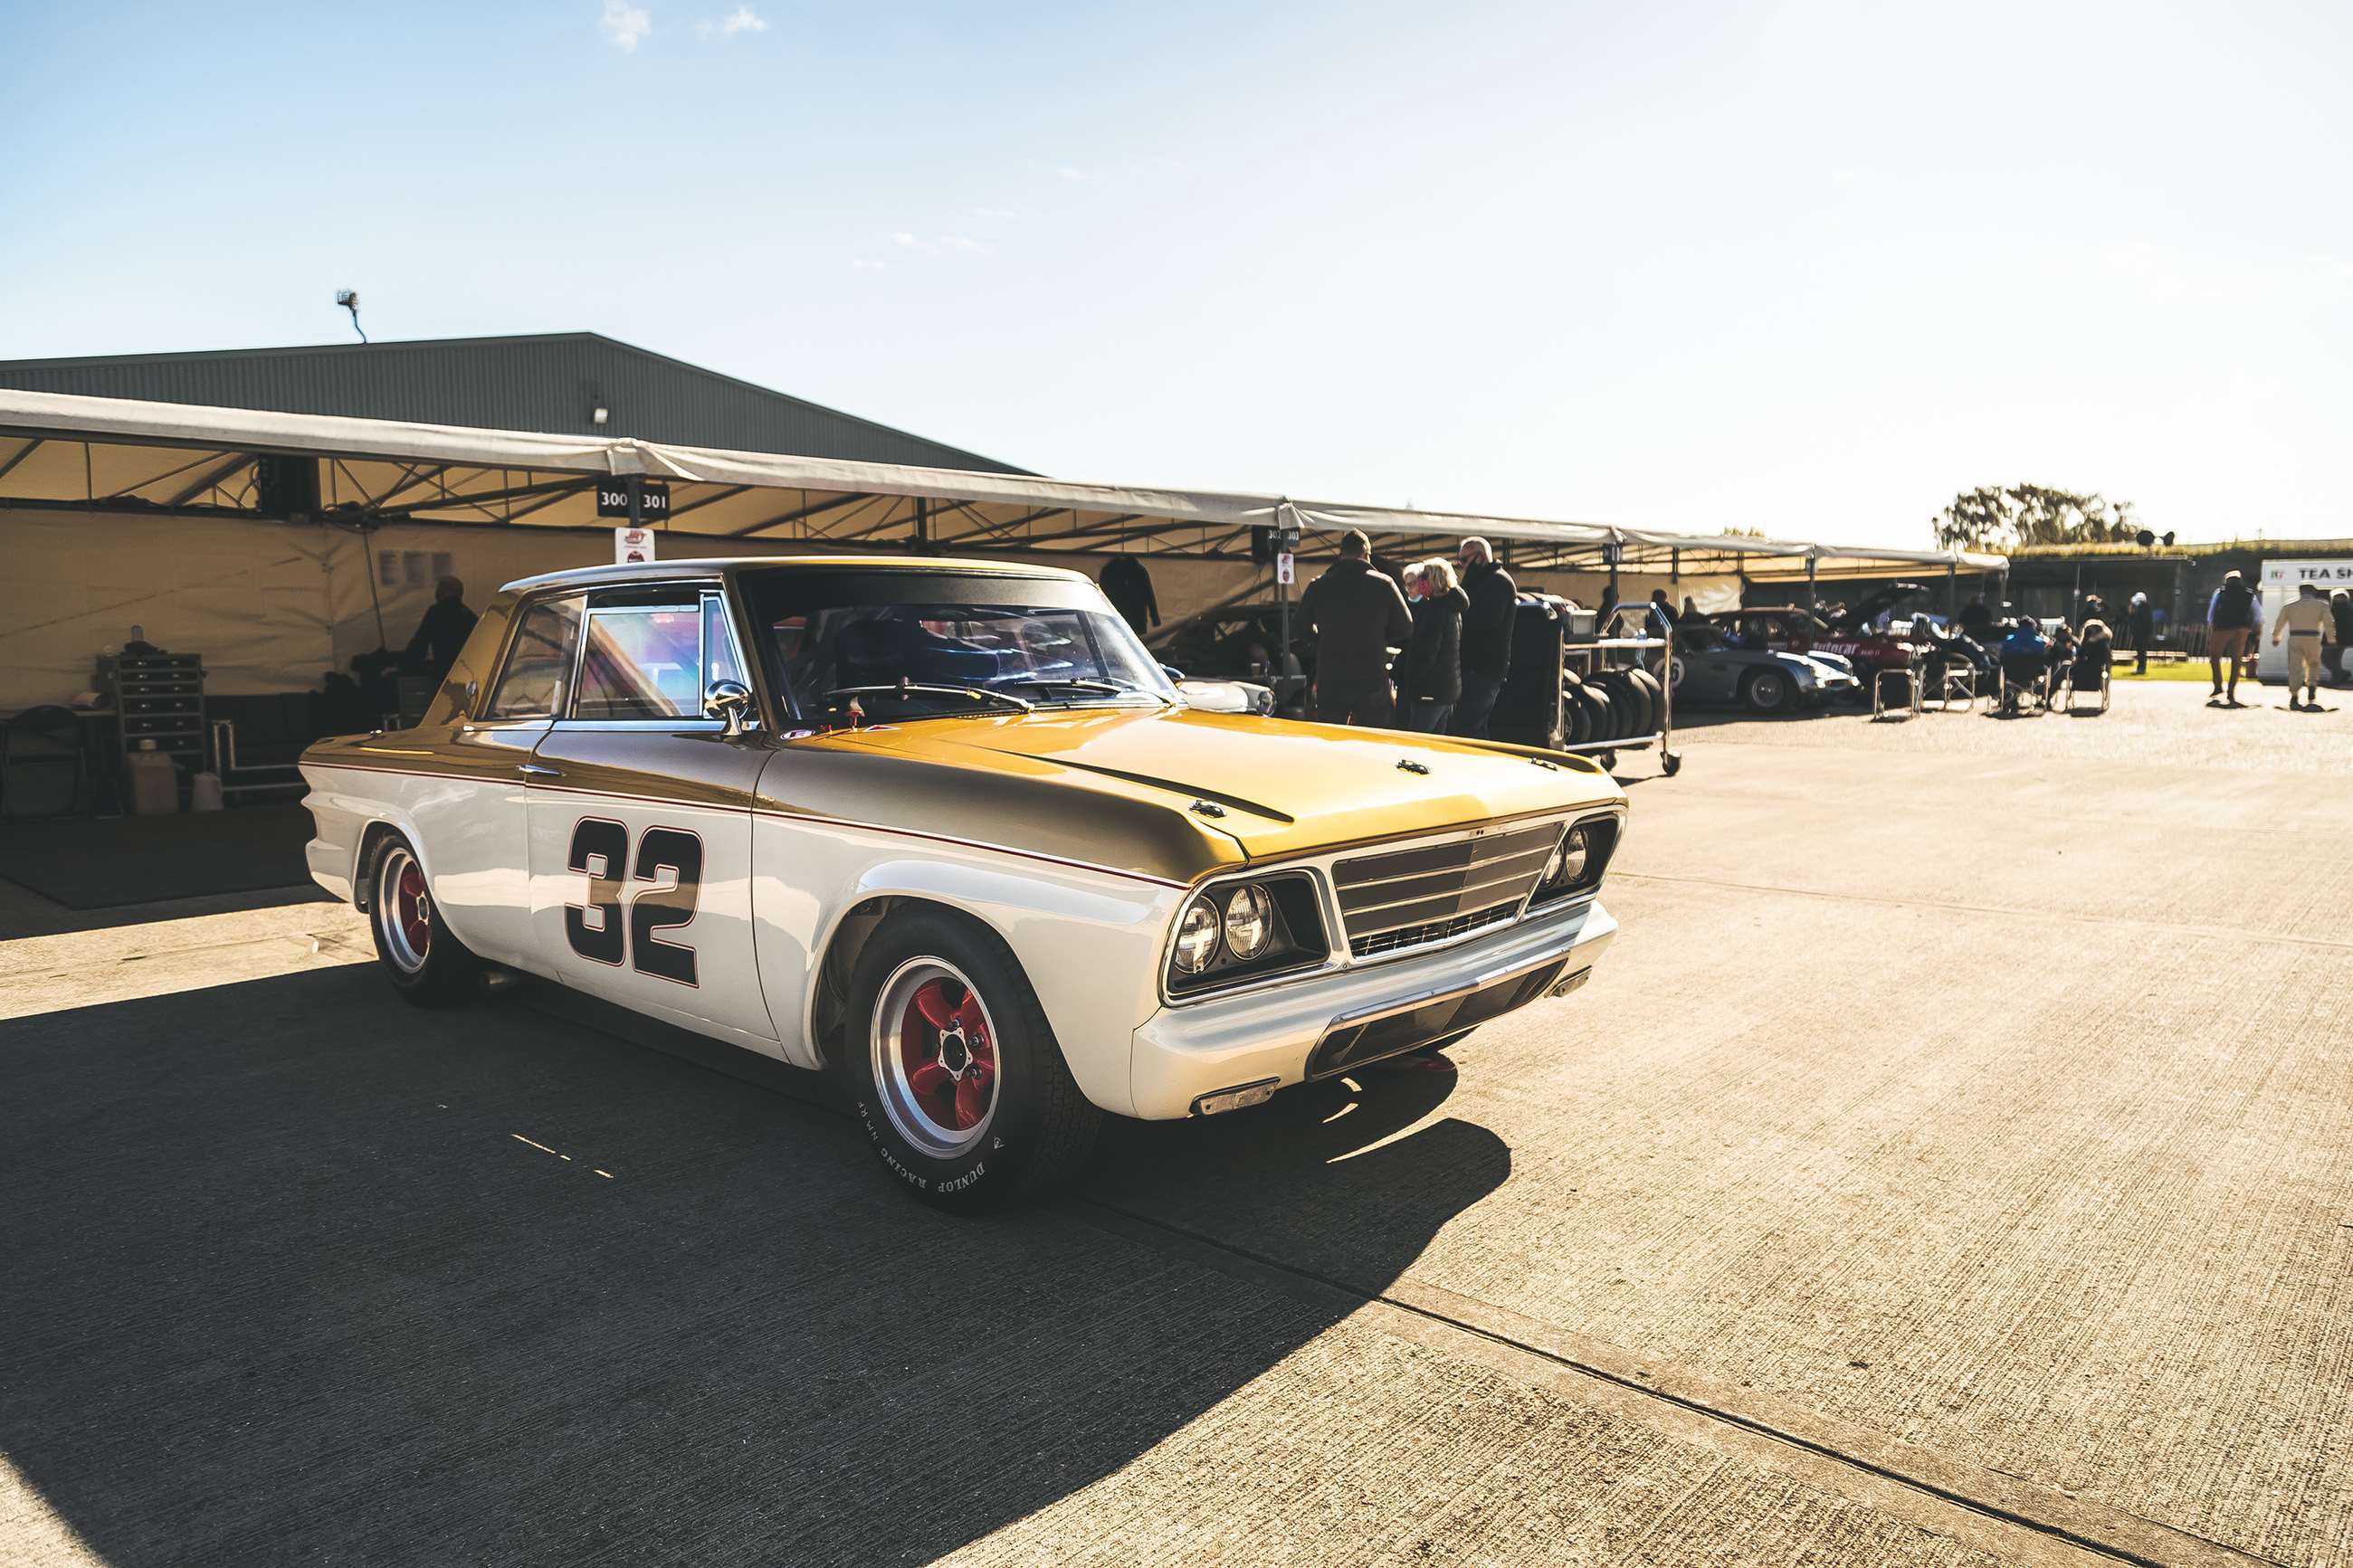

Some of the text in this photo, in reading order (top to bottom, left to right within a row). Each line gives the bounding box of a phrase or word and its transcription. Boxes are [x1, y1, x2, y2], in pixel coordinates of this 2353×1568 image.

[601, 491, 628, 507] 300
[643, 494, 666, 508] 301
[2298, 567, 2330, 579] TEA
[565, 815, 706, 989] 32
[880, 1147, 928, 1190] RACING
[938, 1161, 986, 1193] DUNLOP
